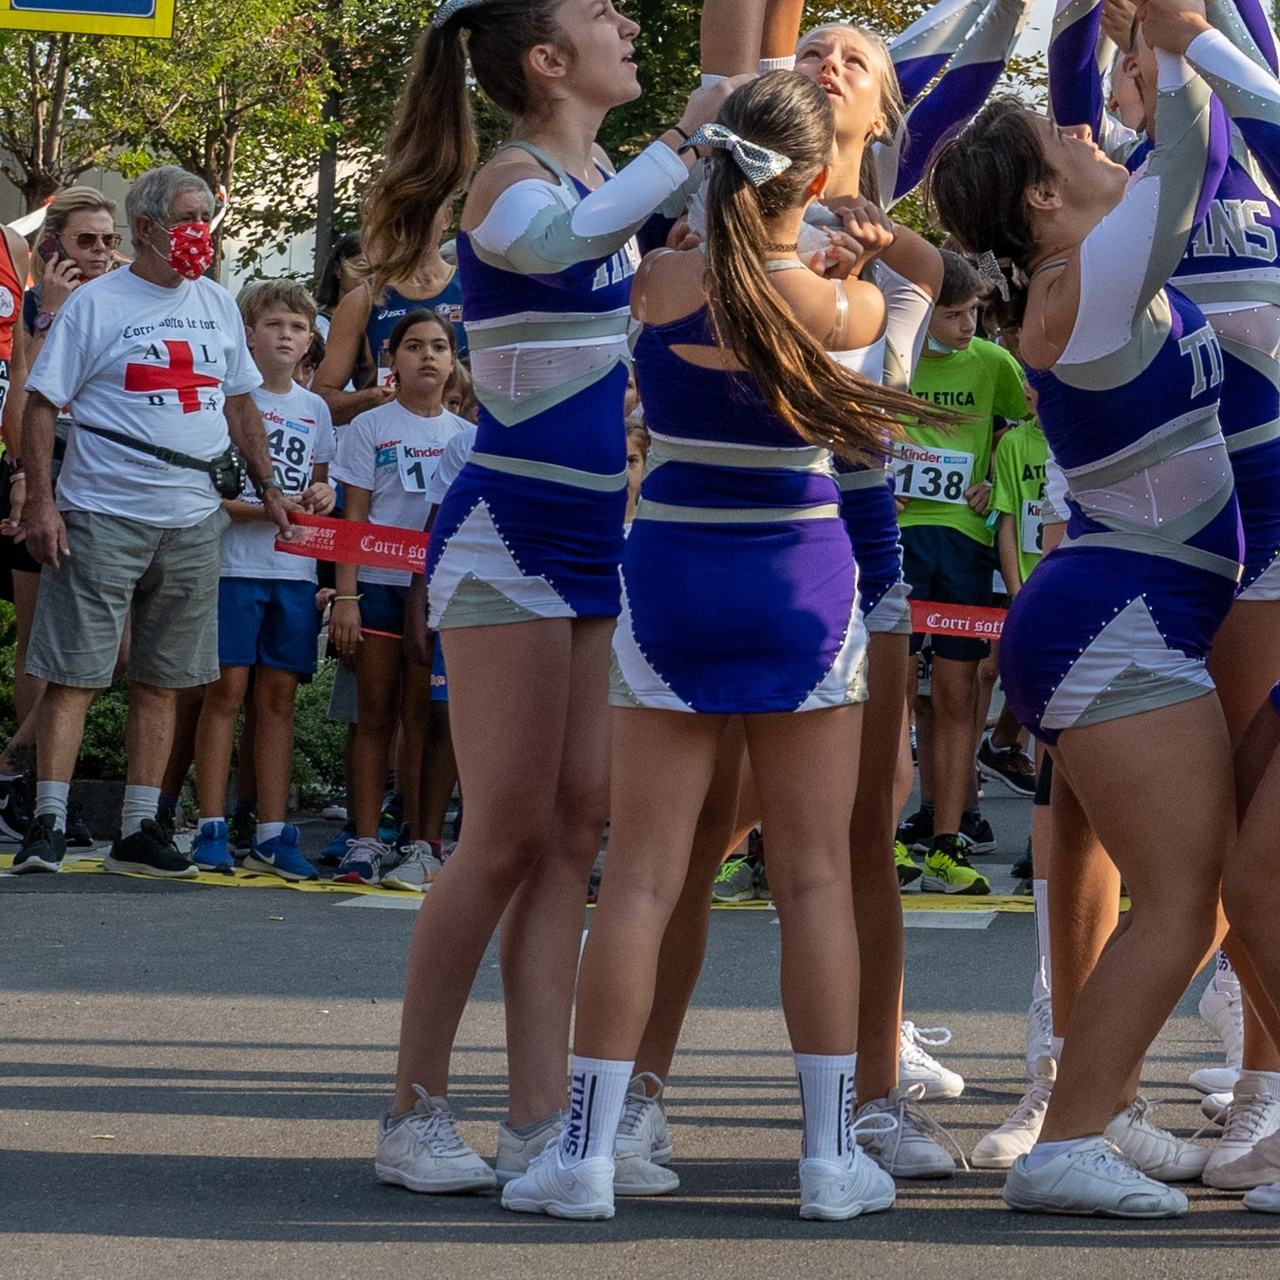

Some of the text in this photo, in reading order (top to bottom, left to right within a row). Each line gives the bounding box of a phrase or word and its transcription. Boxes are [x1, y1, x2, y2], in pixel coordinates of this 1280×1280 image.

[123, 323, 156, 339] Corri
[143, 343, 218, 364] A L
[268, 428, 306, 467] 48
[403, 445, 446, 459] Kinder
[901, 445, 942, 464] Kinder
[896, 463, 965, 501] 138
[361, 534, 404, 556] Corri
[926, 612, 972, 631] Corri
[565, 1072, 586, 1157] TITANS
